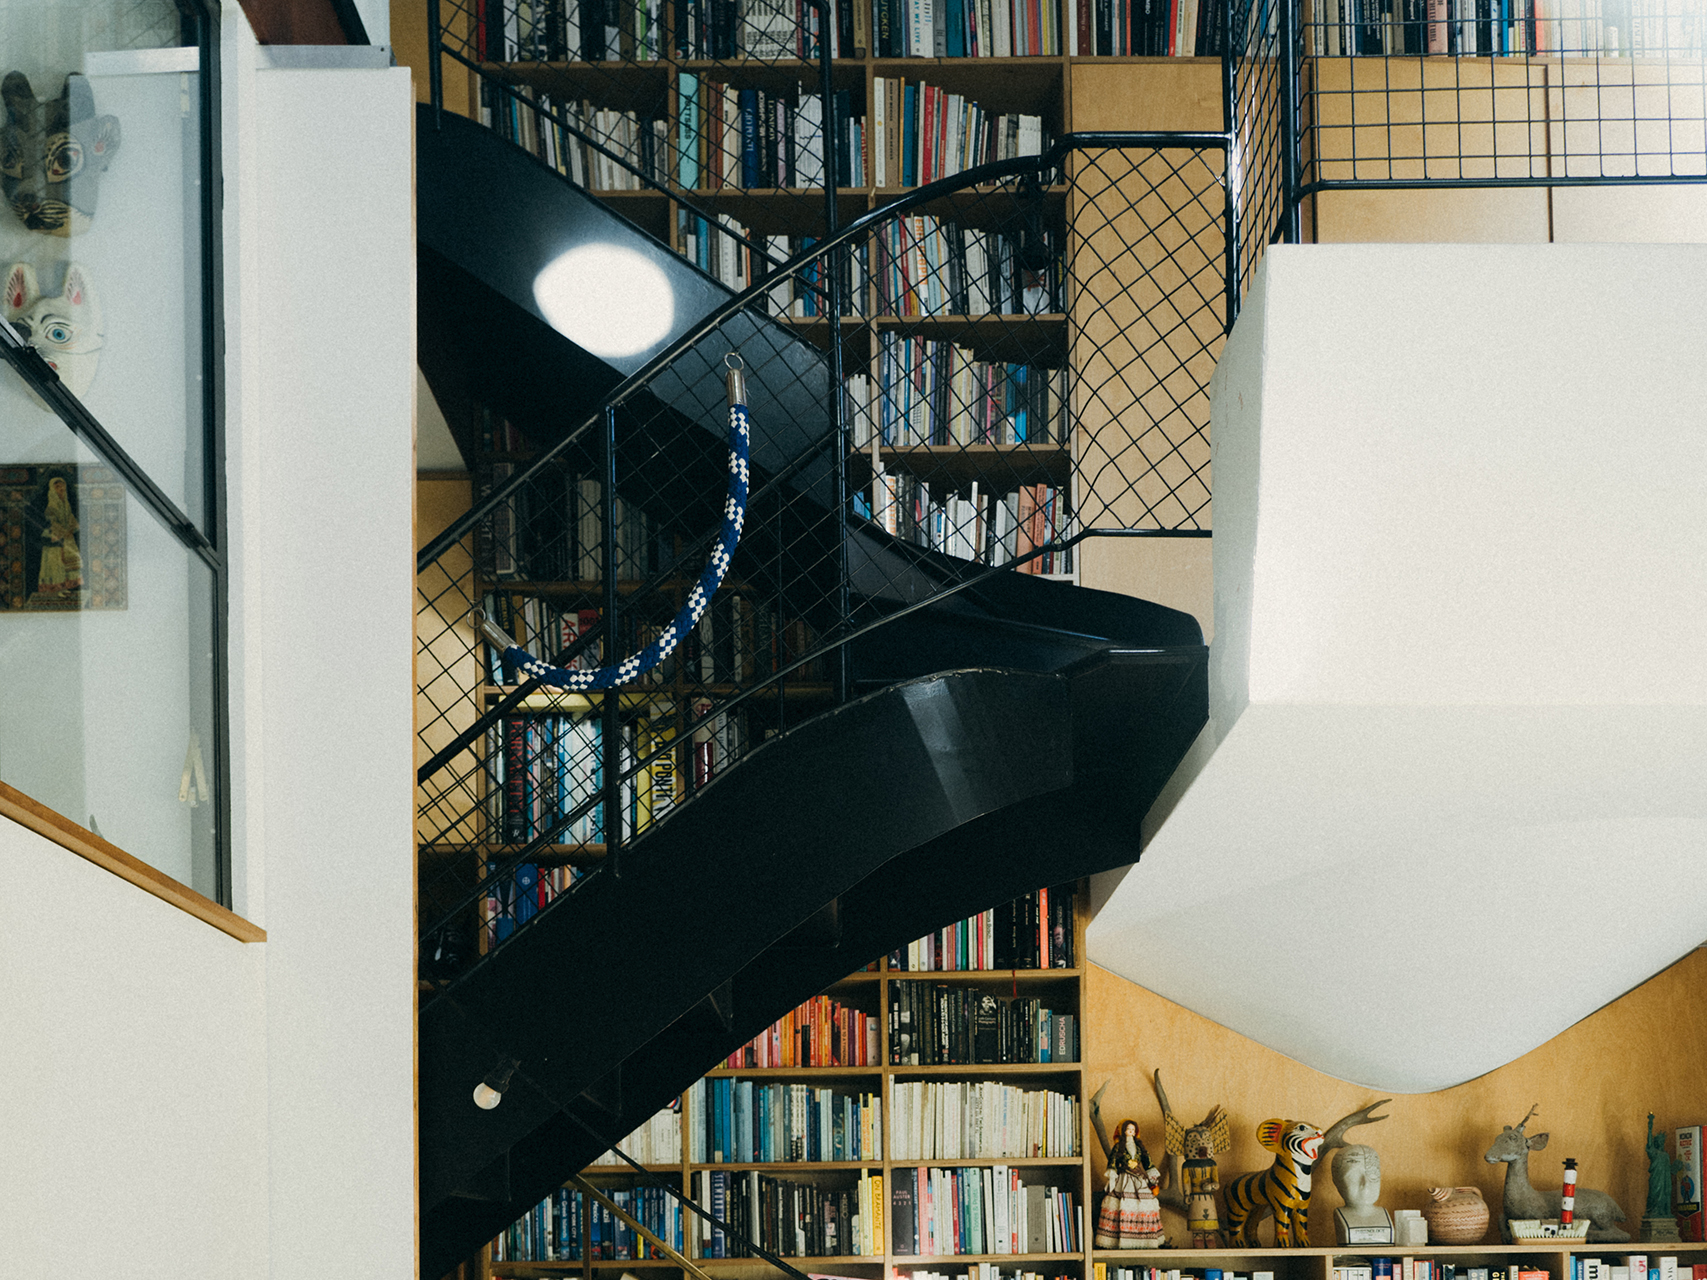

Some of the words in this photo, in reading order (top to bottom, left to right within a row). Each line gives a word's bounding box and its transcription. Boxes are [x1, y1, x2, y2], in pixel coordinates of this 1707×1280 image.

[914, 13, 921, 25] WE
[508, 721, 524, 814] FORNASETTI
[654, 763, 673, 799] PONTI
